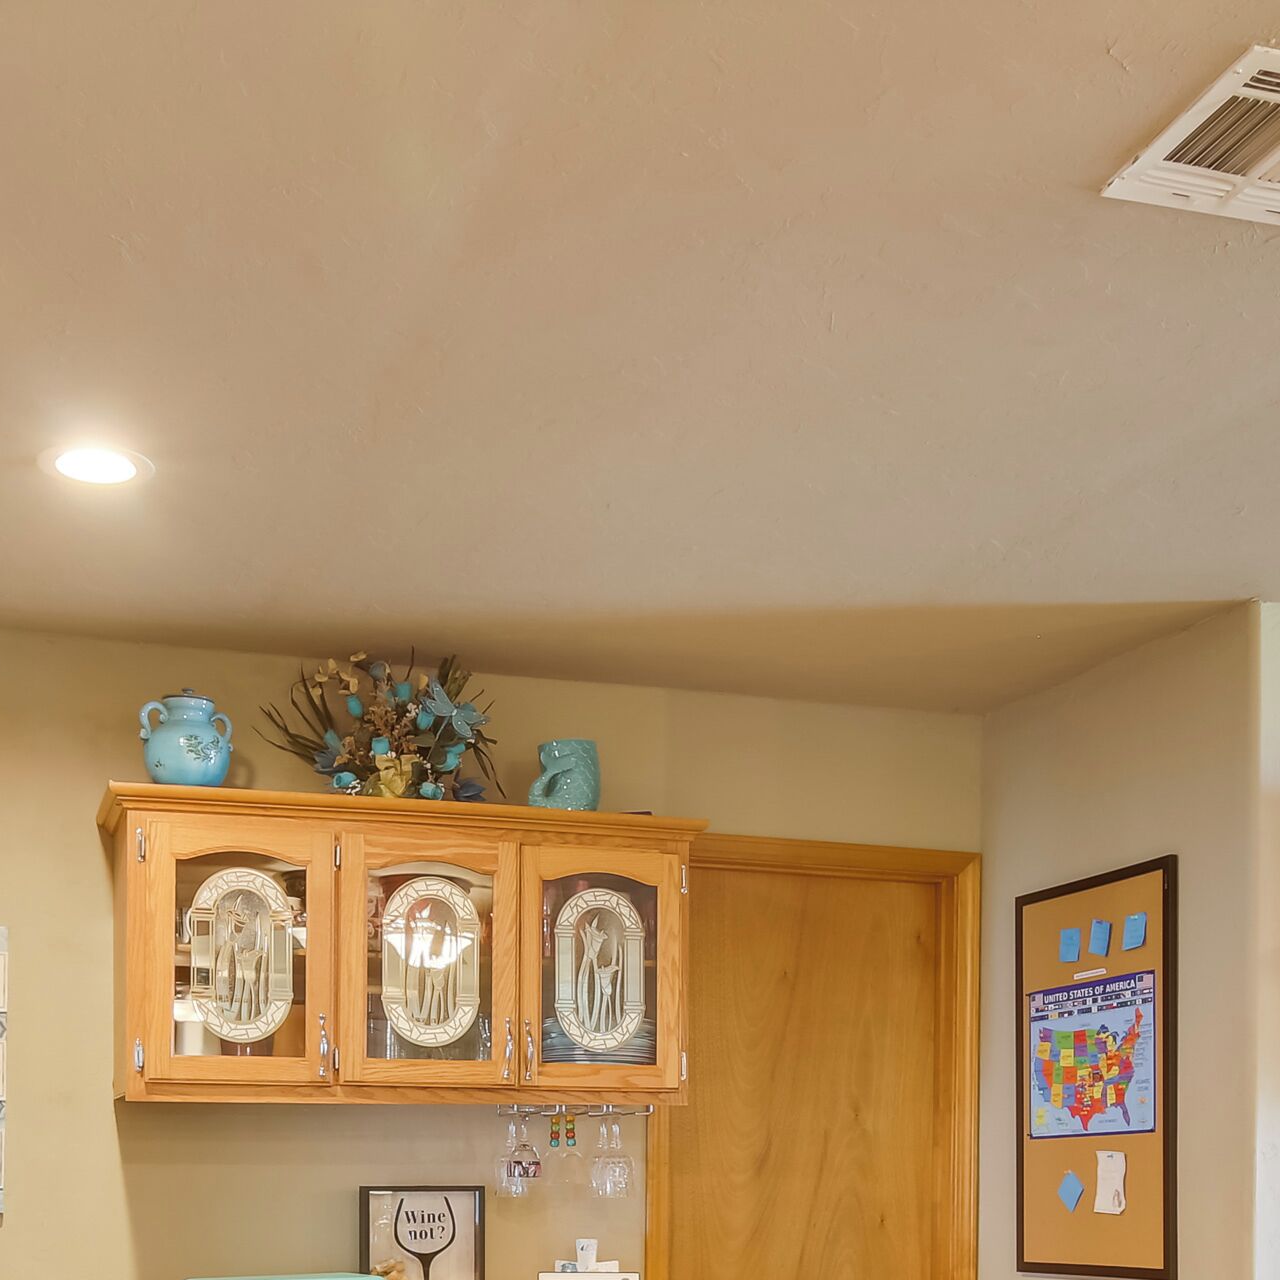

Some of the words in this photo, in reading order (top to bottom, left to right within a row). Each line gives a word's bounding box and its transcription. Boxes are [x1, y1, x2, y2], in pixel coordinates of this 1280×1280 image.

[1043, 991, 1068, 1004] UNITED
[1069, 987, 1093, 1000] STATES
[1095, 985, 1105, 994] OF
[1105, 979, 1136, 993] AMERICA
[404, 1210, 446, 1224] Wine
[408, 1226, 446, 1241] not?
